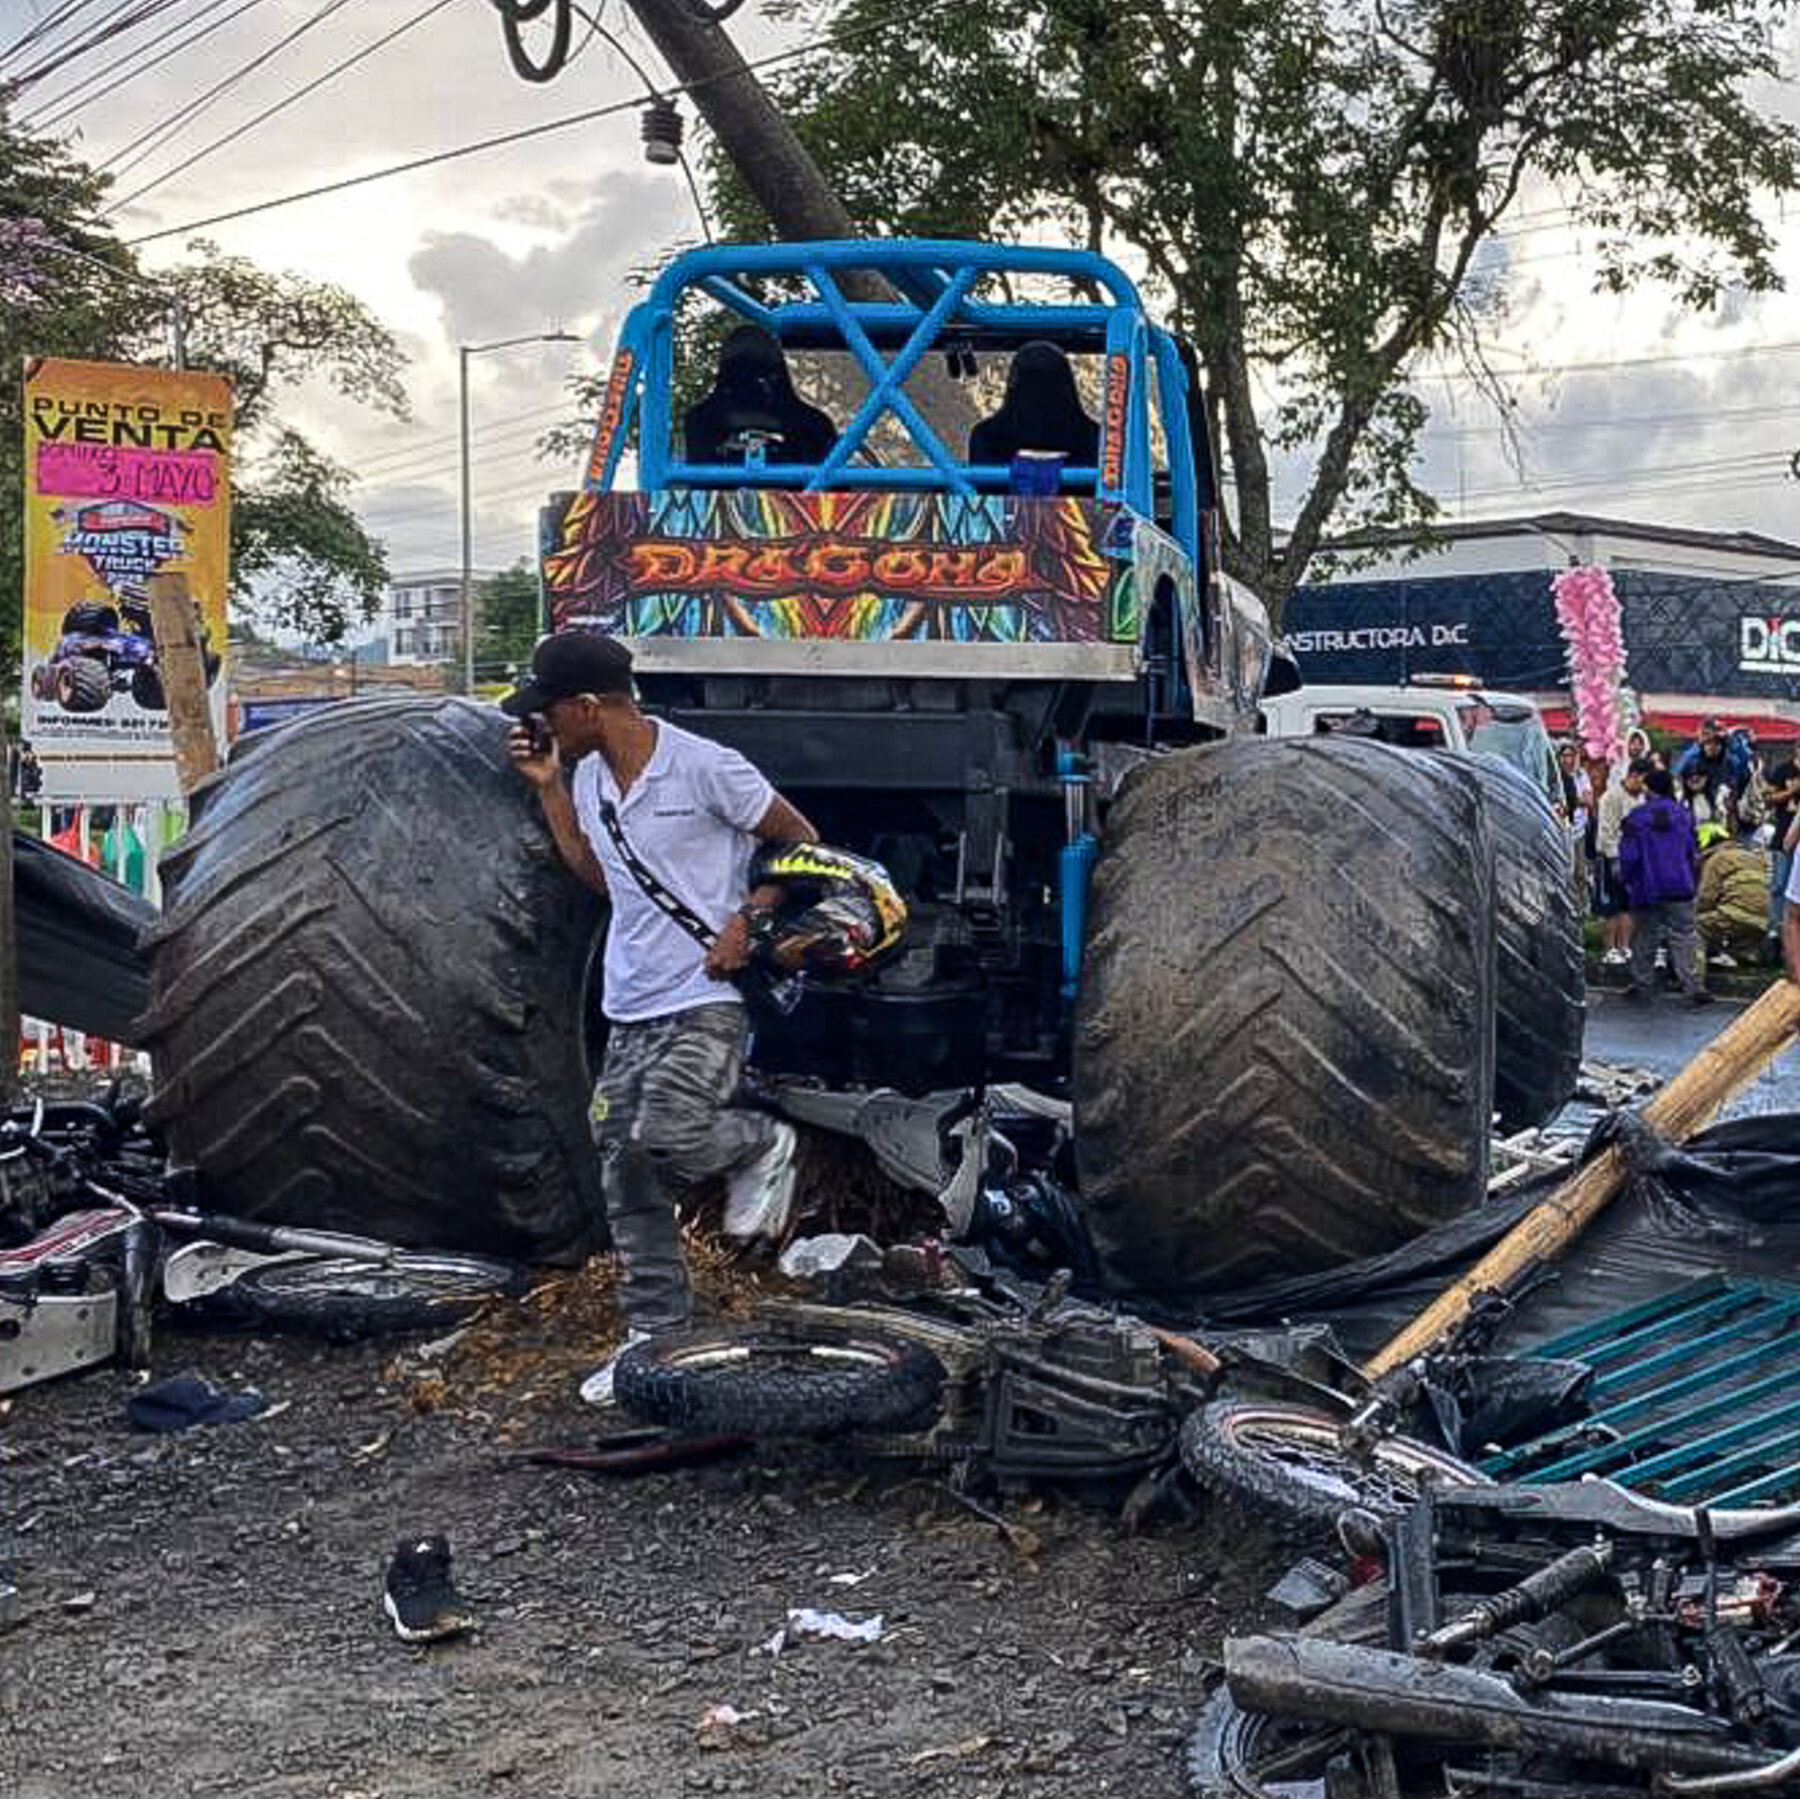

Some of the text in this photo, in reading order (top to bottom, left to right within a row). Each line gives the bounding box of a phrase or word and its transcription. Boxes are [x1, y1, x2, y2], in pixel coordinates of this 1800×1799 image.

[33, 397, 228, 428] PUNTO DE
[33, 414, 226, 454] VENTA
[133, 458, 215, 502] MAYO
[63, 531, 187, 558] MONSTER
[628, 541, 1028, 591] DRAGONA
[1282, 627, 1427, 652] NSTRUCTORA
